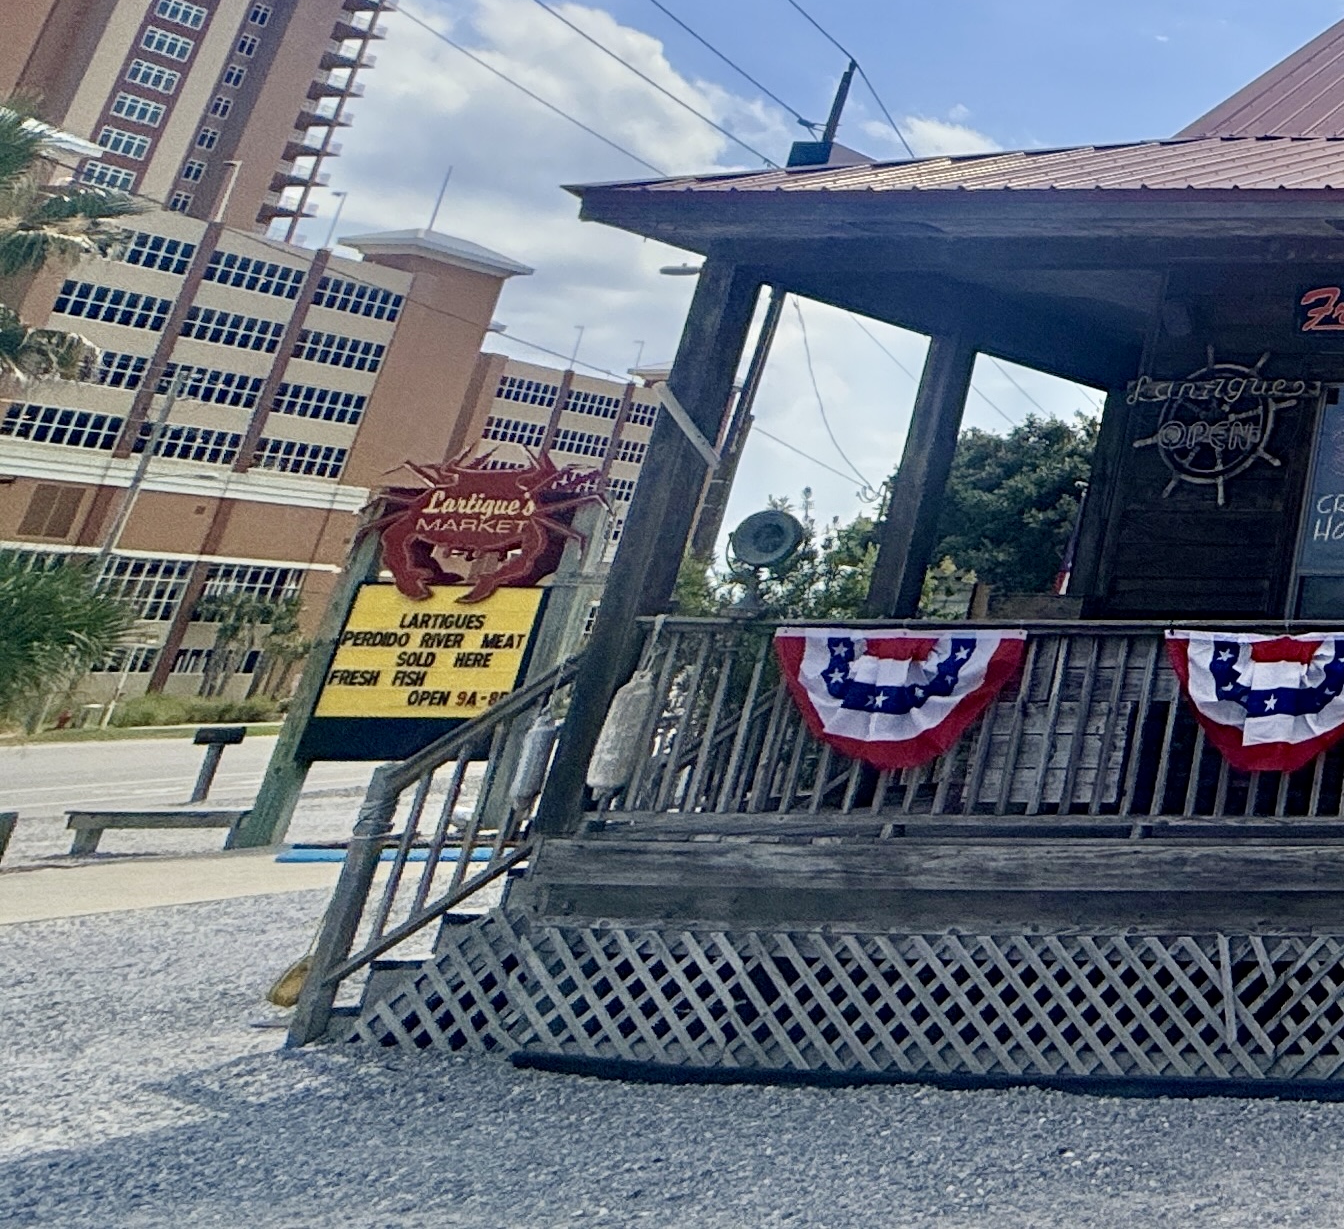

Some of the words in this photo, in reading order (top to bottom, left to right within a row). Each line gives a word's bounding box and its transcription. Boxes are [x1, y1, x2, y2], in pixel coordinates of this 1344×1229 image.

[1159, 419, 1256, 451] OPEN
[422, 490, 536, 521] Lartigue's
[415, 518, 530, 535] MARKET
[399, 613, 487, 630] LARTIGUES
[340, 631, 411, 648] PERDIDO
[418, 633, 465, 649] RIVER
[481, 633, 527, 649] MEAT
[396, 652, 437, 668] SOLD
[453, 652, 494, 668] HERE
[327, 670, 381, 687] FRESH
[391, 671, 429, 687] FISH
[407, 691, 451, 707] OPEN
